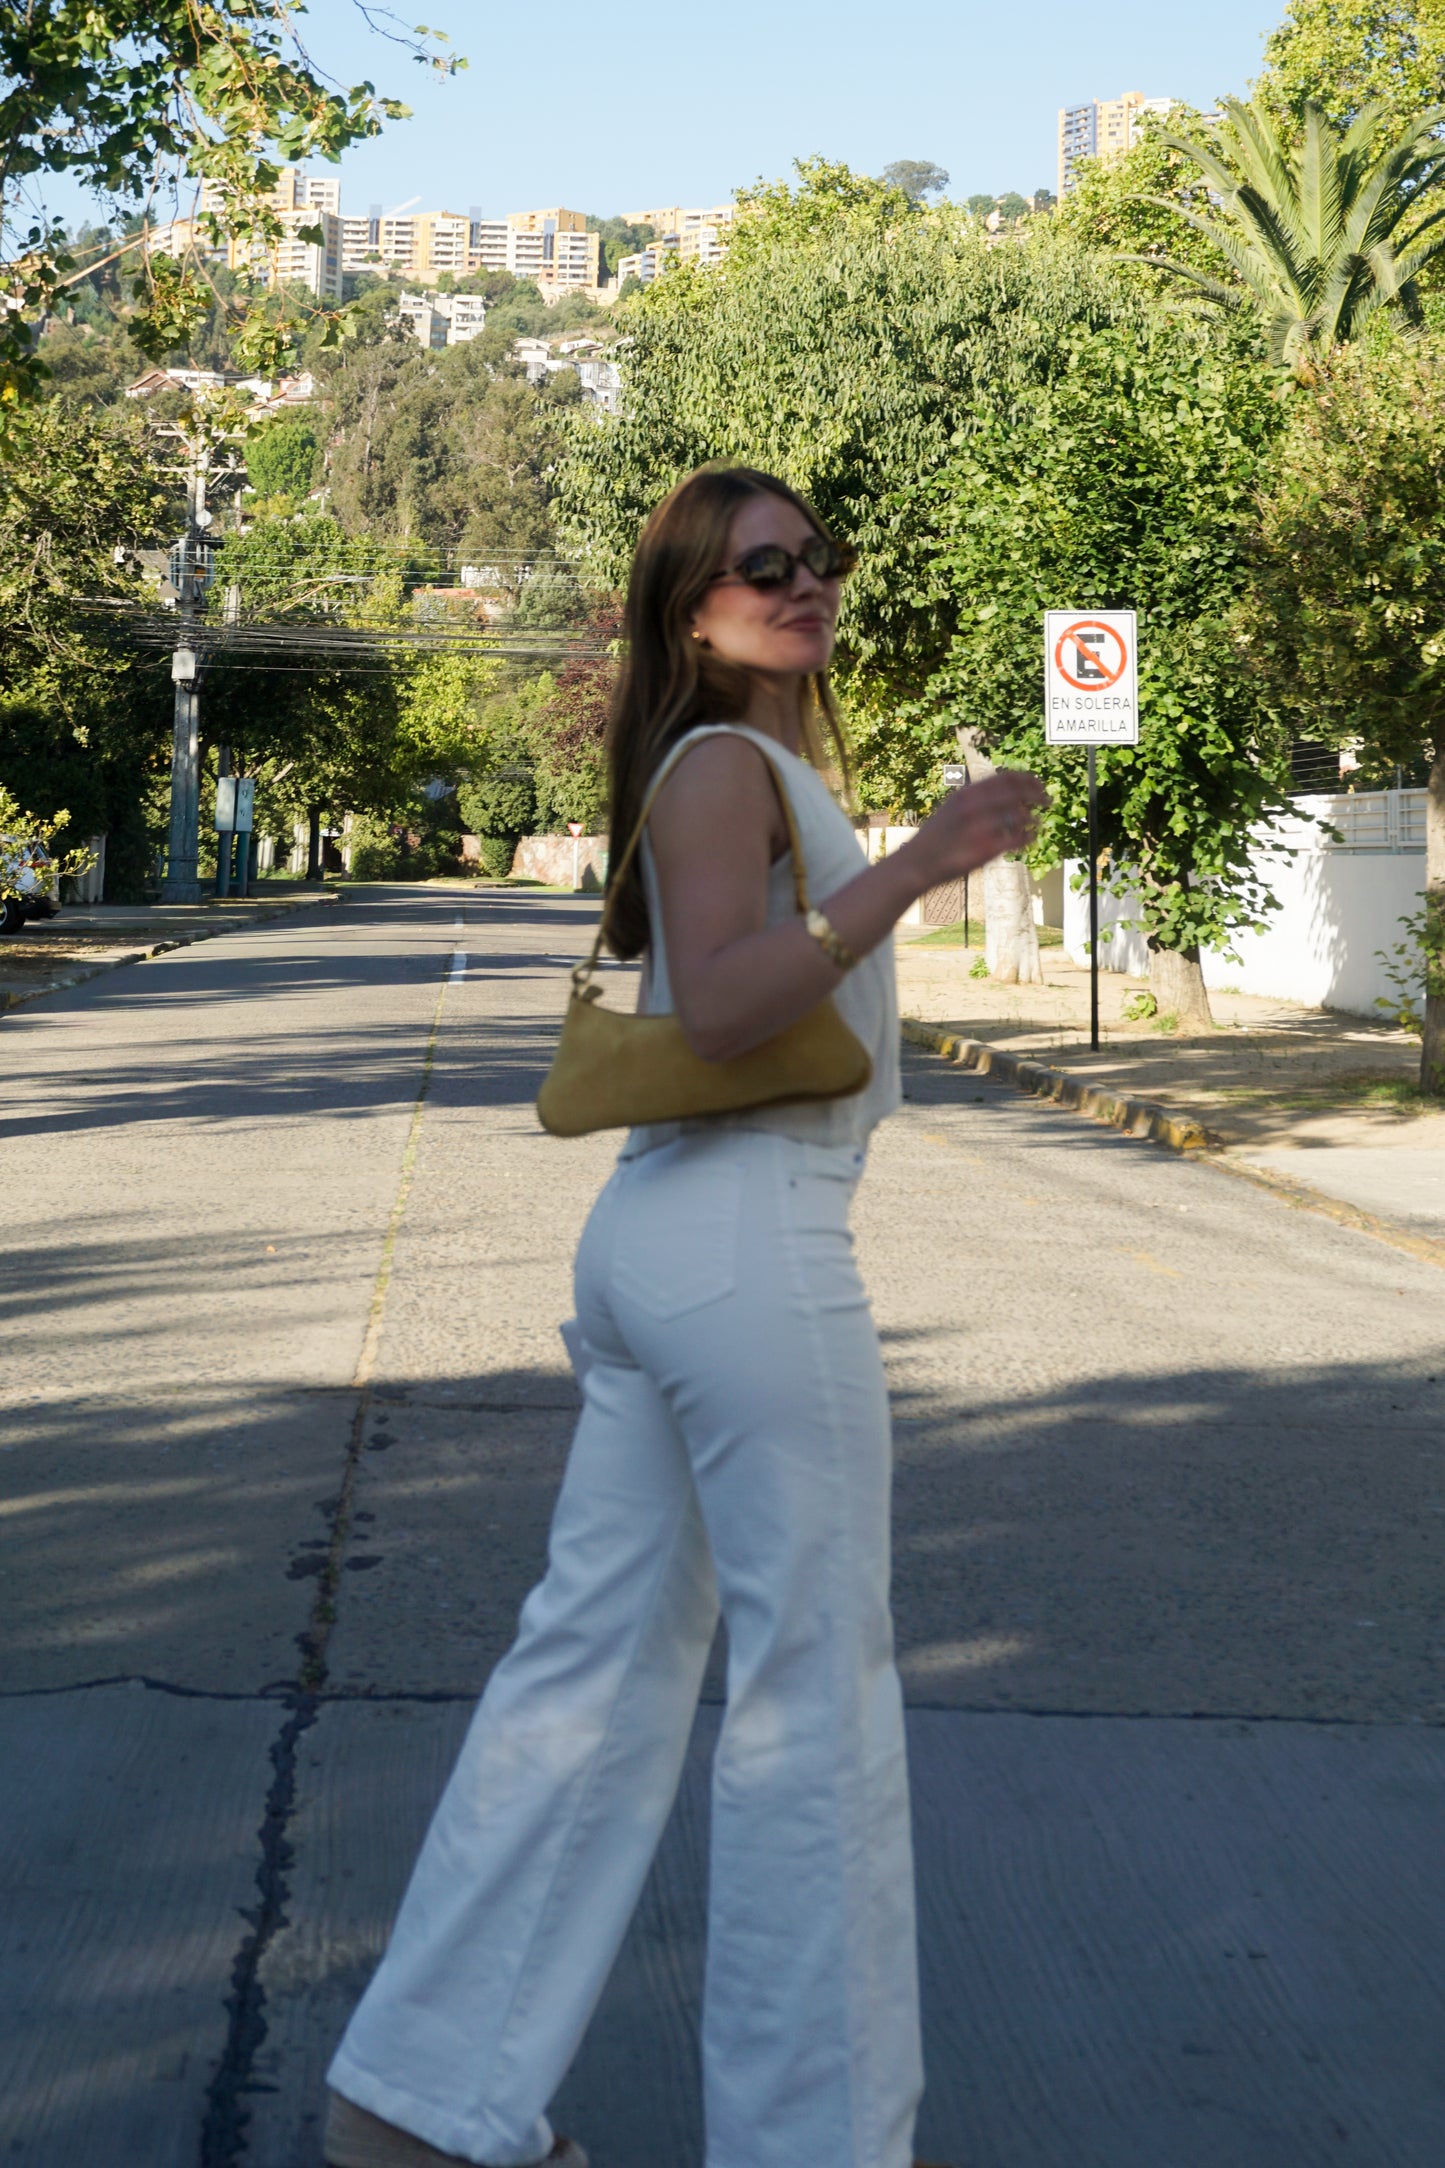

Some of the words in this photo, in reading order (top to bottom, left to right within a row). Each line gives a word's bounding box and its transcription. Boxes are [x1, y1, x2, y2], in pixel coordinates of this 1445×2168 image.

[1076, 633, 1106, 679] E
[1052, 697, 1070, 710] EN
[1074, 697, 1132, 710] SOLERA
[1056, 719, 1128, 732] AMARILLA
